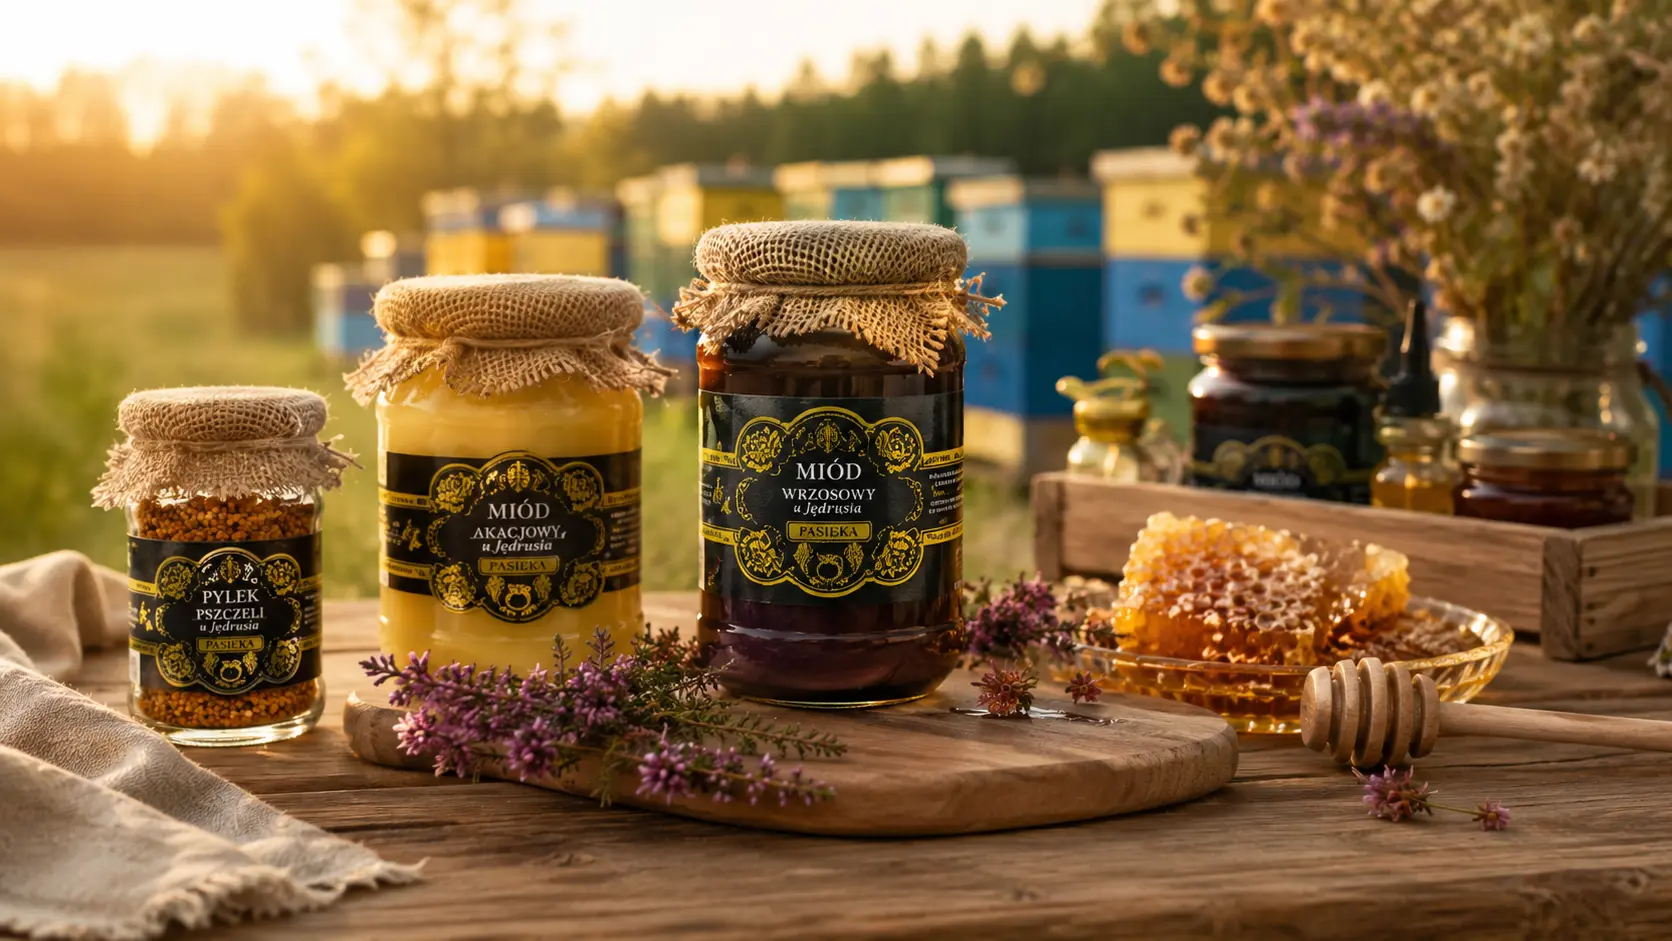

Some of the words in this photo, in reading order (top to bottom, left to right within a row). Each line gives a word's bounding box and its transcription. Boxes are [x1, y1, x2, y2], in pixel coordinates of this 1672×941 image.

[796, 457, 862, 481] MIÓD
[781, 487, 876, 501] WRZOSOWY
[487, 498, 550, 520] MIÓD
[793, 504, 801, 514] u
[802, 501, 862, 517] Jędrusia
[799, 525, 859, 538] PASIEKA
[482, 543, 491, 552] u
[491, 539, 553, 555] Jędrusia
[488, 560, 547, 572] PASIEKA
[202, 588, 260, 604] PYLEK
[195, 606, 265, 621] PSZCZELI
[199, 624, 207, 632] u
[208, 619, 260, 635] Jędrusia
[205, 639, 255, 650] PASIEKA
